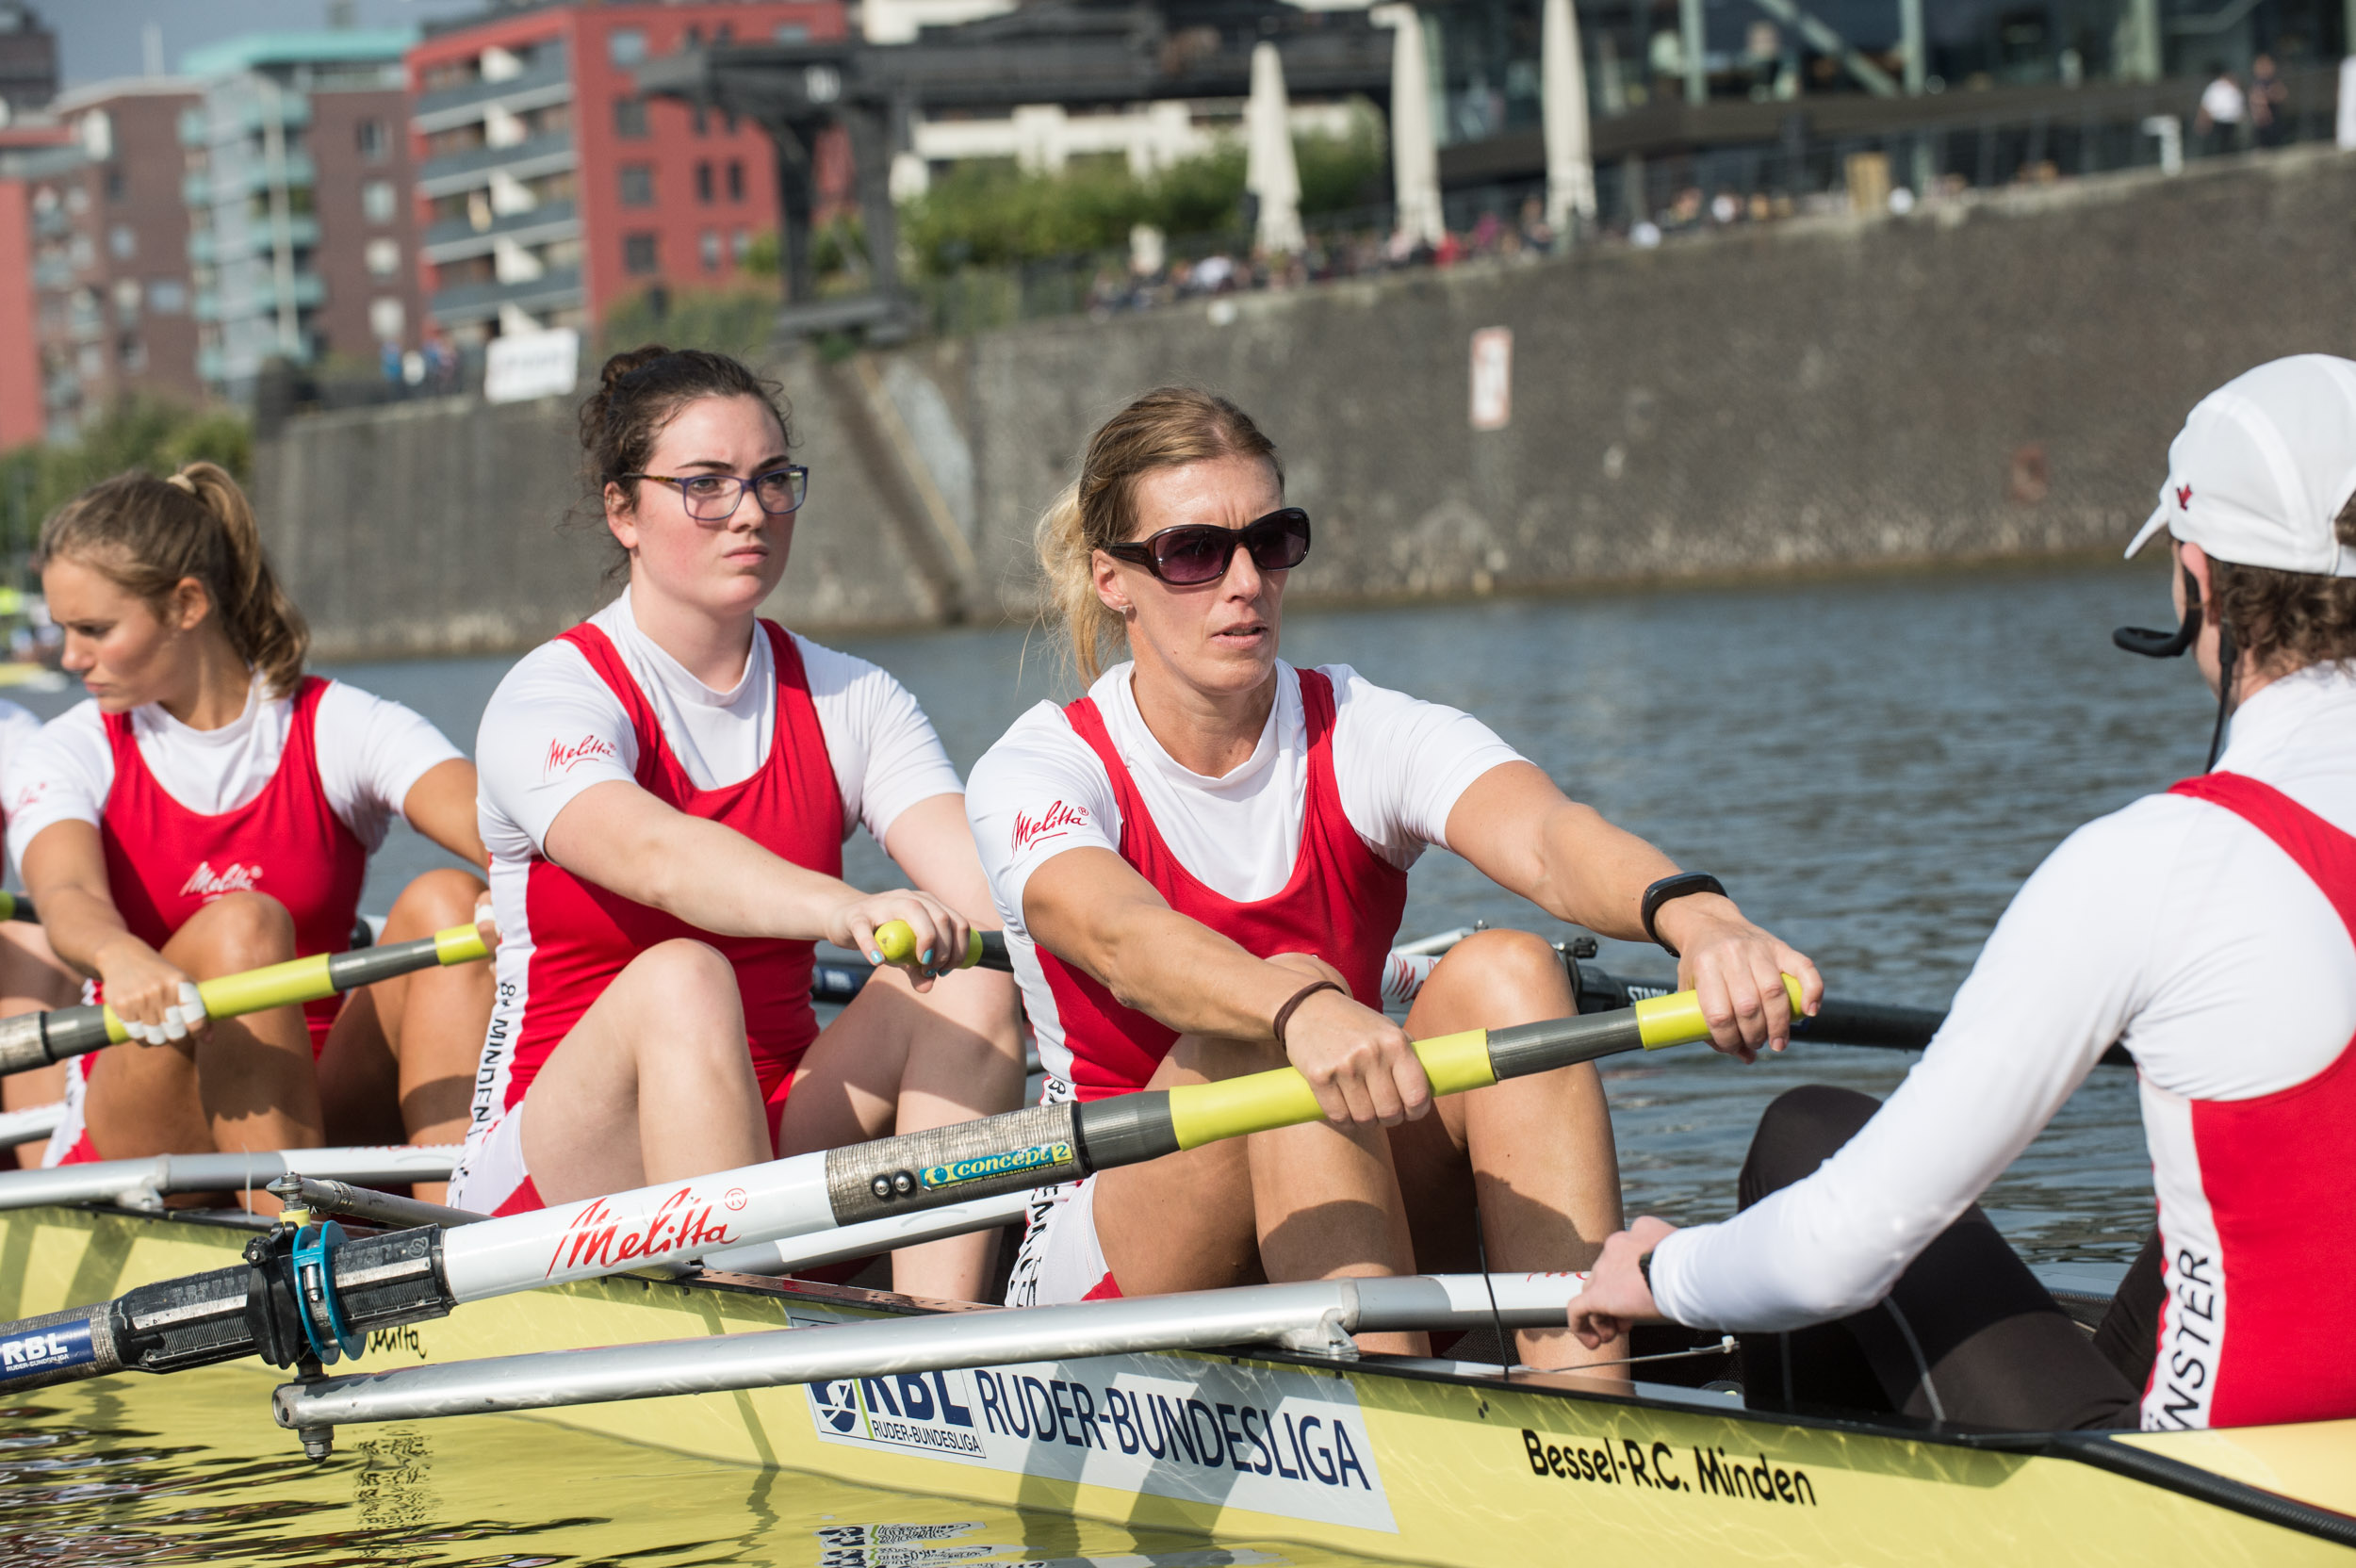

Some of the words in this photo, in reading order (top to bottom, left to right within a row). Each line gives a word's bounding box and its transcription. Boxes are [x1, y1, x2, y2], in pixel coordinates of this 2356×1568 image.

[473, 1019, 509, 1123] MINDEN
[957, 1147, 1049, 1176] concept
[1056, 1145, 1068, 1158] 2
[2, 1332, 68, 1365] RBL
[872, 1420, 982, 1453] RUDER-BUNDESLIGA
[973, 1369, 1372, 1491] RUDER-BUNDESLIGA
[1521, 1429, 1691, 1493] Bessel-R.C.
[1693, 1446, 1817, 1507] Minden
